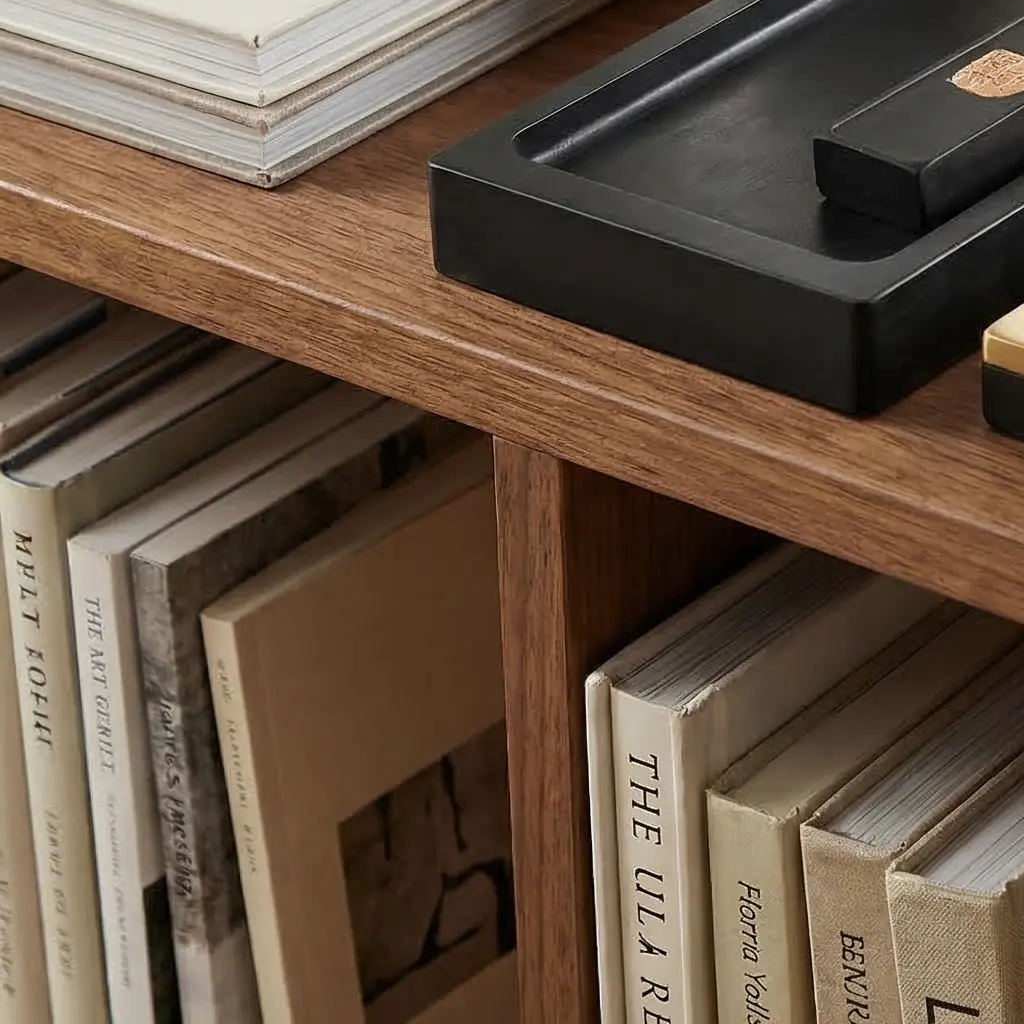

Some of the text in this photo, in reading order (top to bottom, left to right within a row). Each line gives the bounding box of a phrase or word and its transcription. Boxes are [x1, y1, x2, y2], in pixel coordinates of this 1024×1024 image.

[84, 597, 104, 641] THE
[628, 753, 662, 845] THE
[634, 867, 667, 957] ULA
